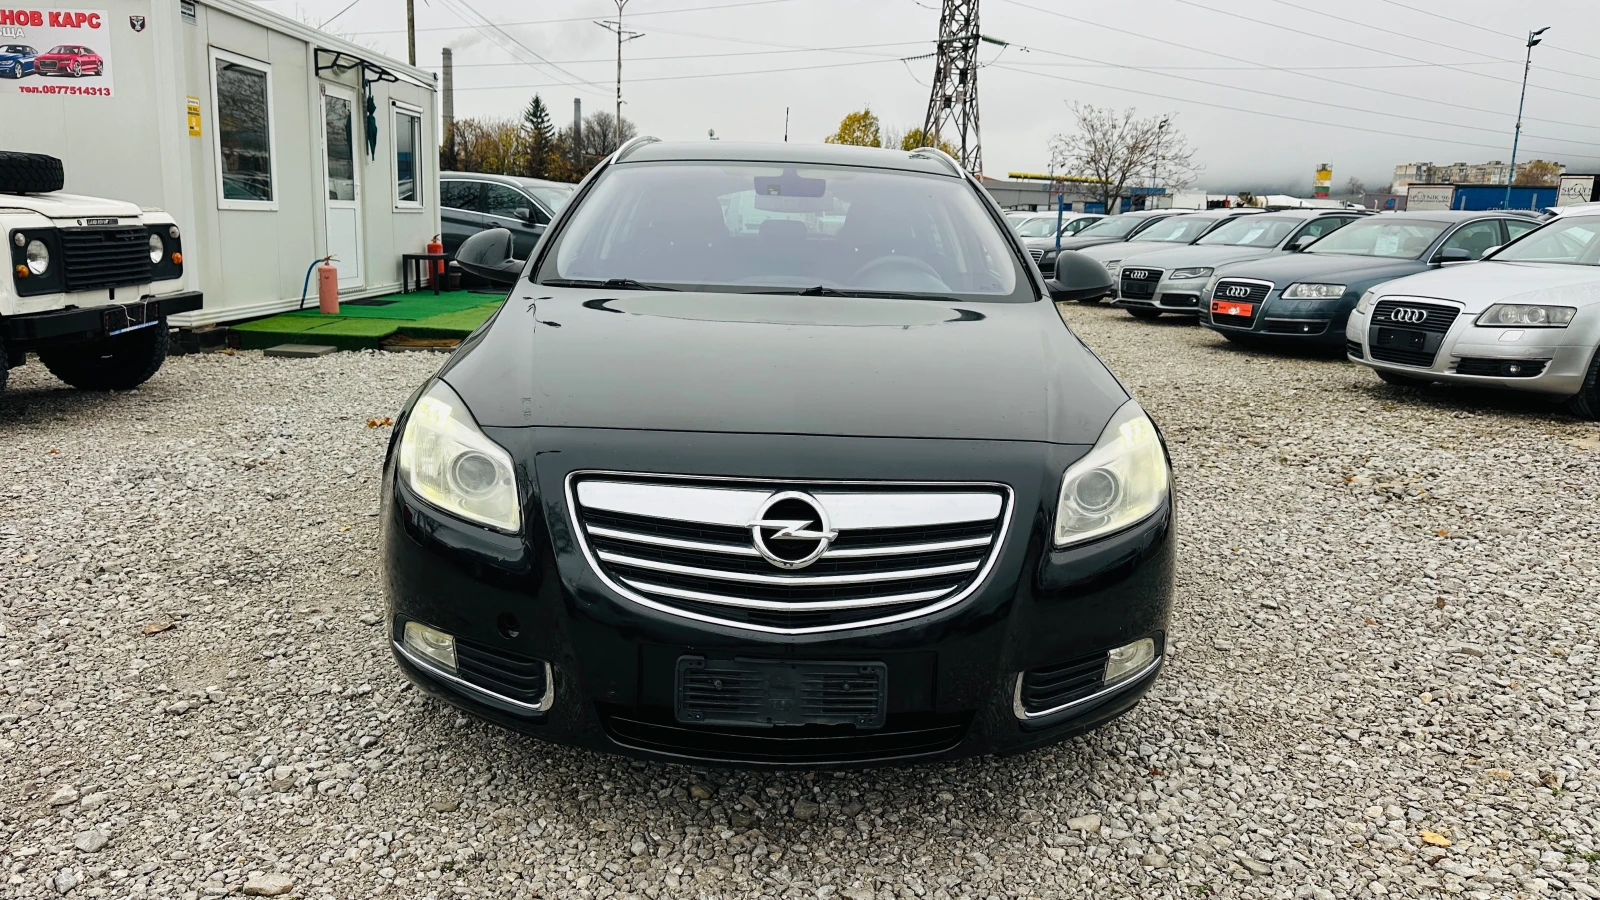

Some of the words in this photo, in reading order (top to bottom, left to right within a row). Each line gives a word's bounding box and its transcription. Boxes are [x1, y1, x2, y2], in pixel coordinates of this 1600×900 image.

[0, 9, 43, 26] НОВ
[48, 11, 101, 29] КАРС
[19, 85, 111, 96] тел.0877514313
